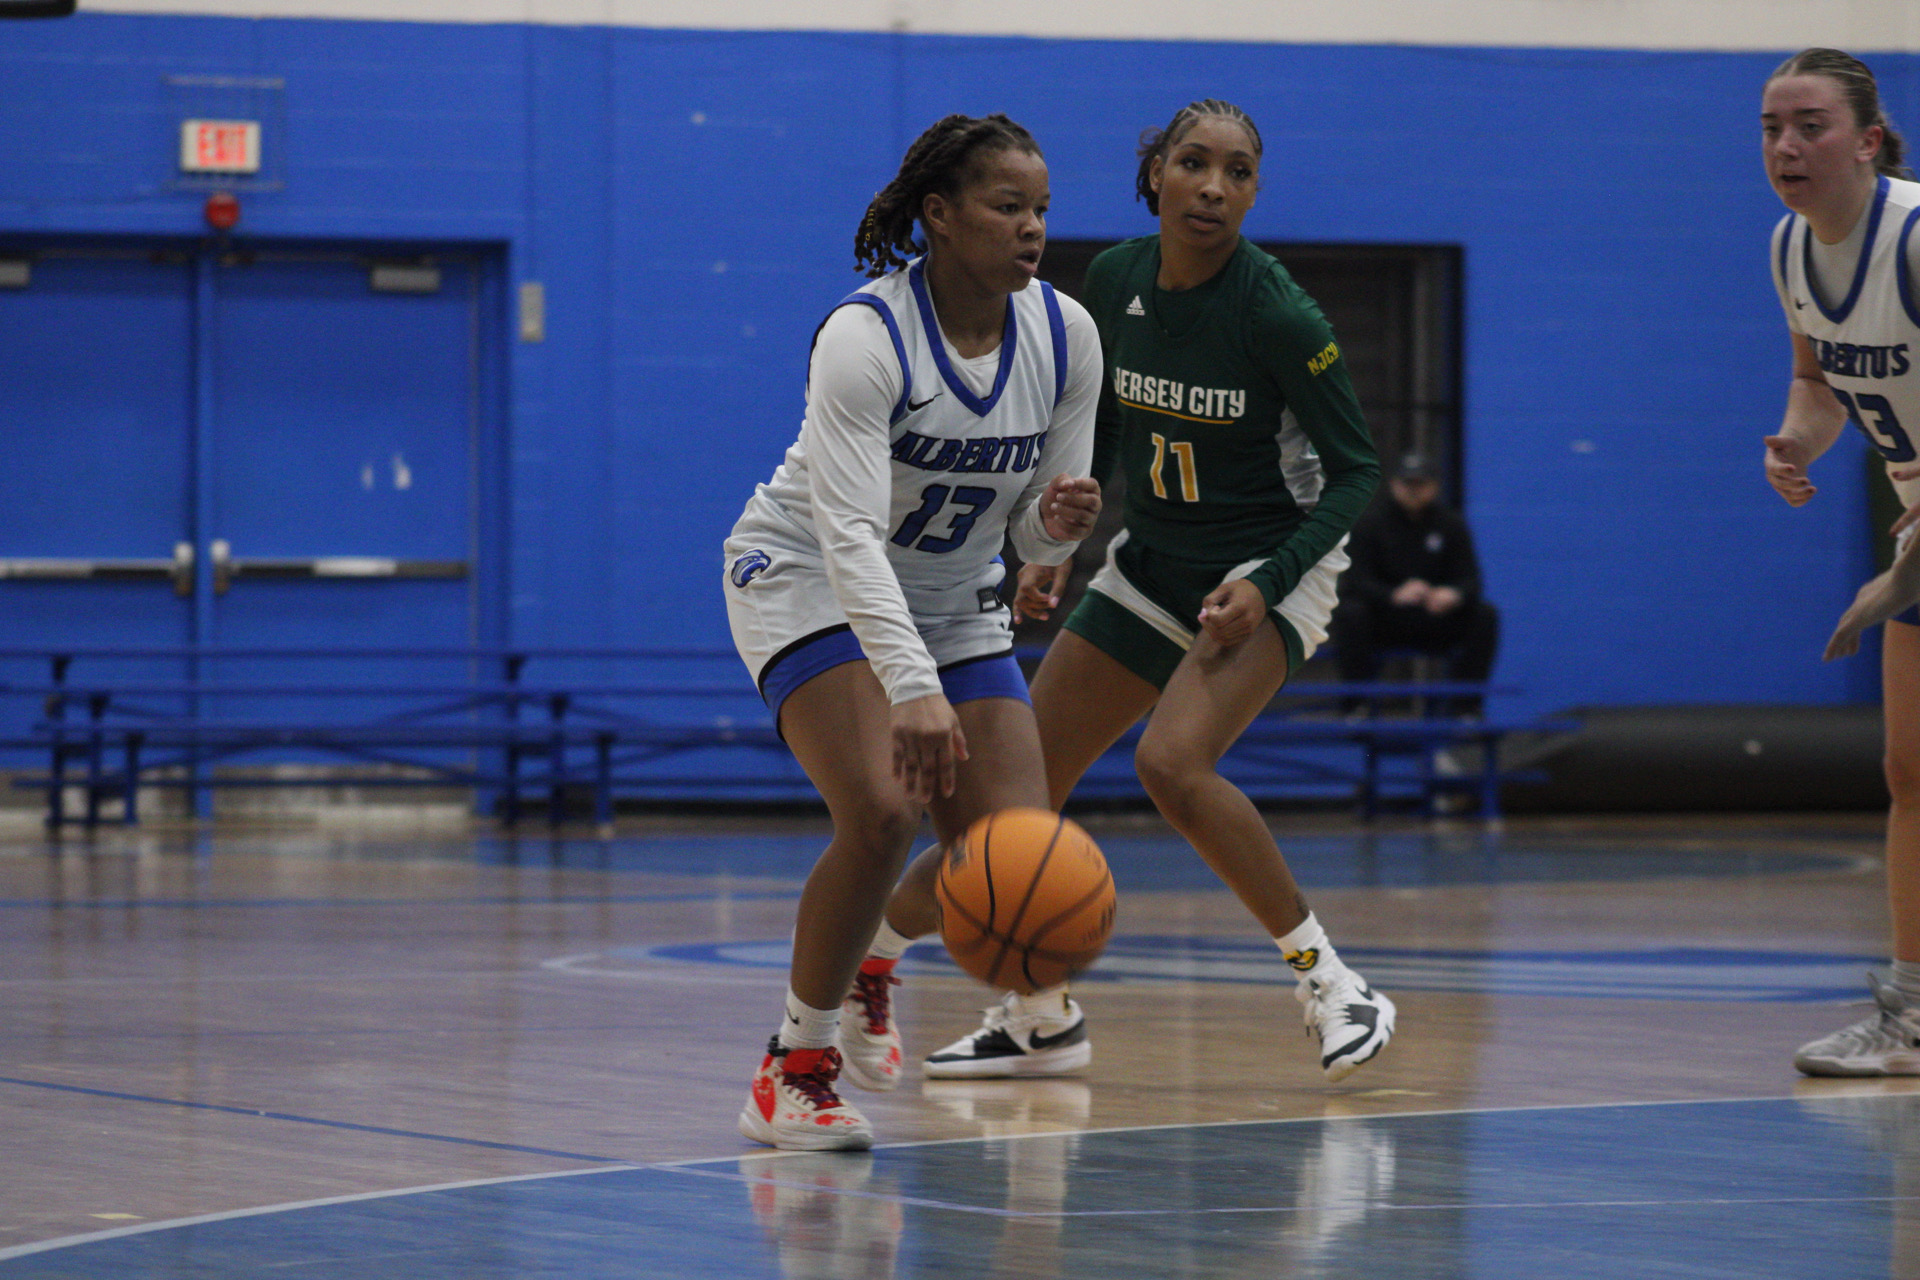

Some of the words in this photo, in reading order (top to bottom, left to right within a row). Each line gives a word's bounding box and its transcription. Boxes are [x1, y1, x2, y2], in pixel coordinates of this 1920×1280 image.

[1307, 341, 1339, 376] NJCU
[1114, 366, 1184, 411] JERSEY
[1189, 386, 1246, 418] CITY
[890, 429, 1048, 474] ALBERTUS
[1150, 432, 1200, 502] 11
[890, 483, 997, 554] 13
